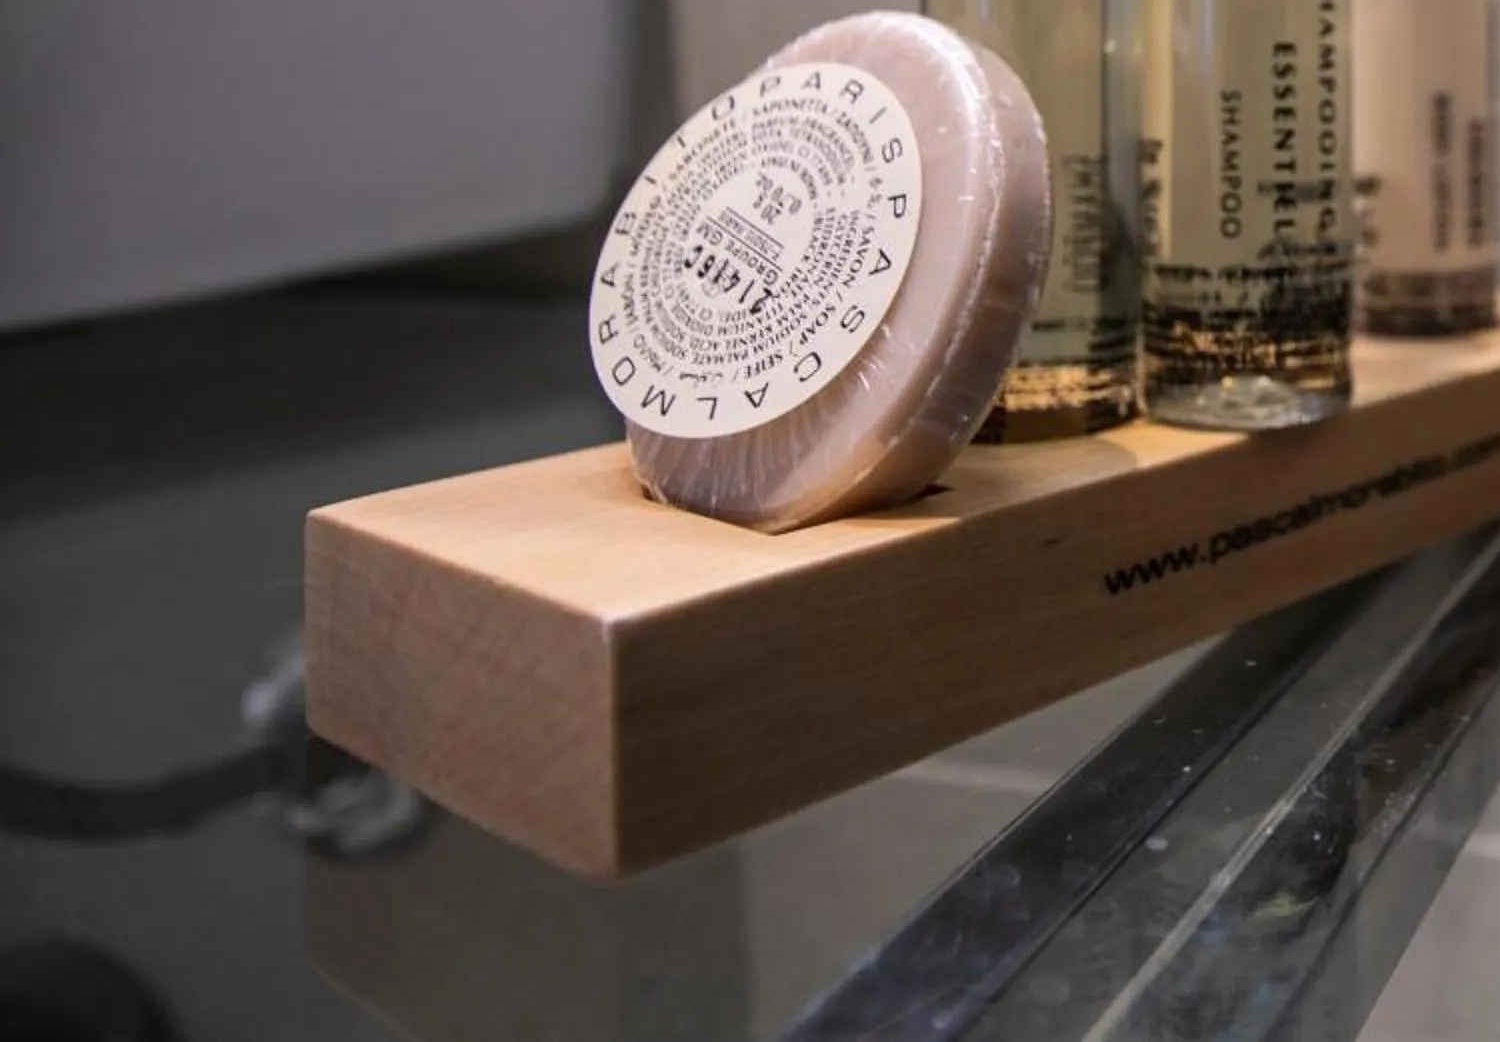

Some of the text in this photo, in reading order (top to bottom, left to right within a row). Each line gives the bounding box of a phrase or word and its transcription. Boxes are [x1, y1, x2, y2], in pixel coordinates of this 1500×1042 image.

[1219, 89, 1243, 239] SHAMPOO
[1272, 41, 1297, 230] ESSENTIEL
[840, 223, 877, 288] SAVON
[796, 301, 837, 348] SOAP
[744, 347, 783, 380] SEIFE
